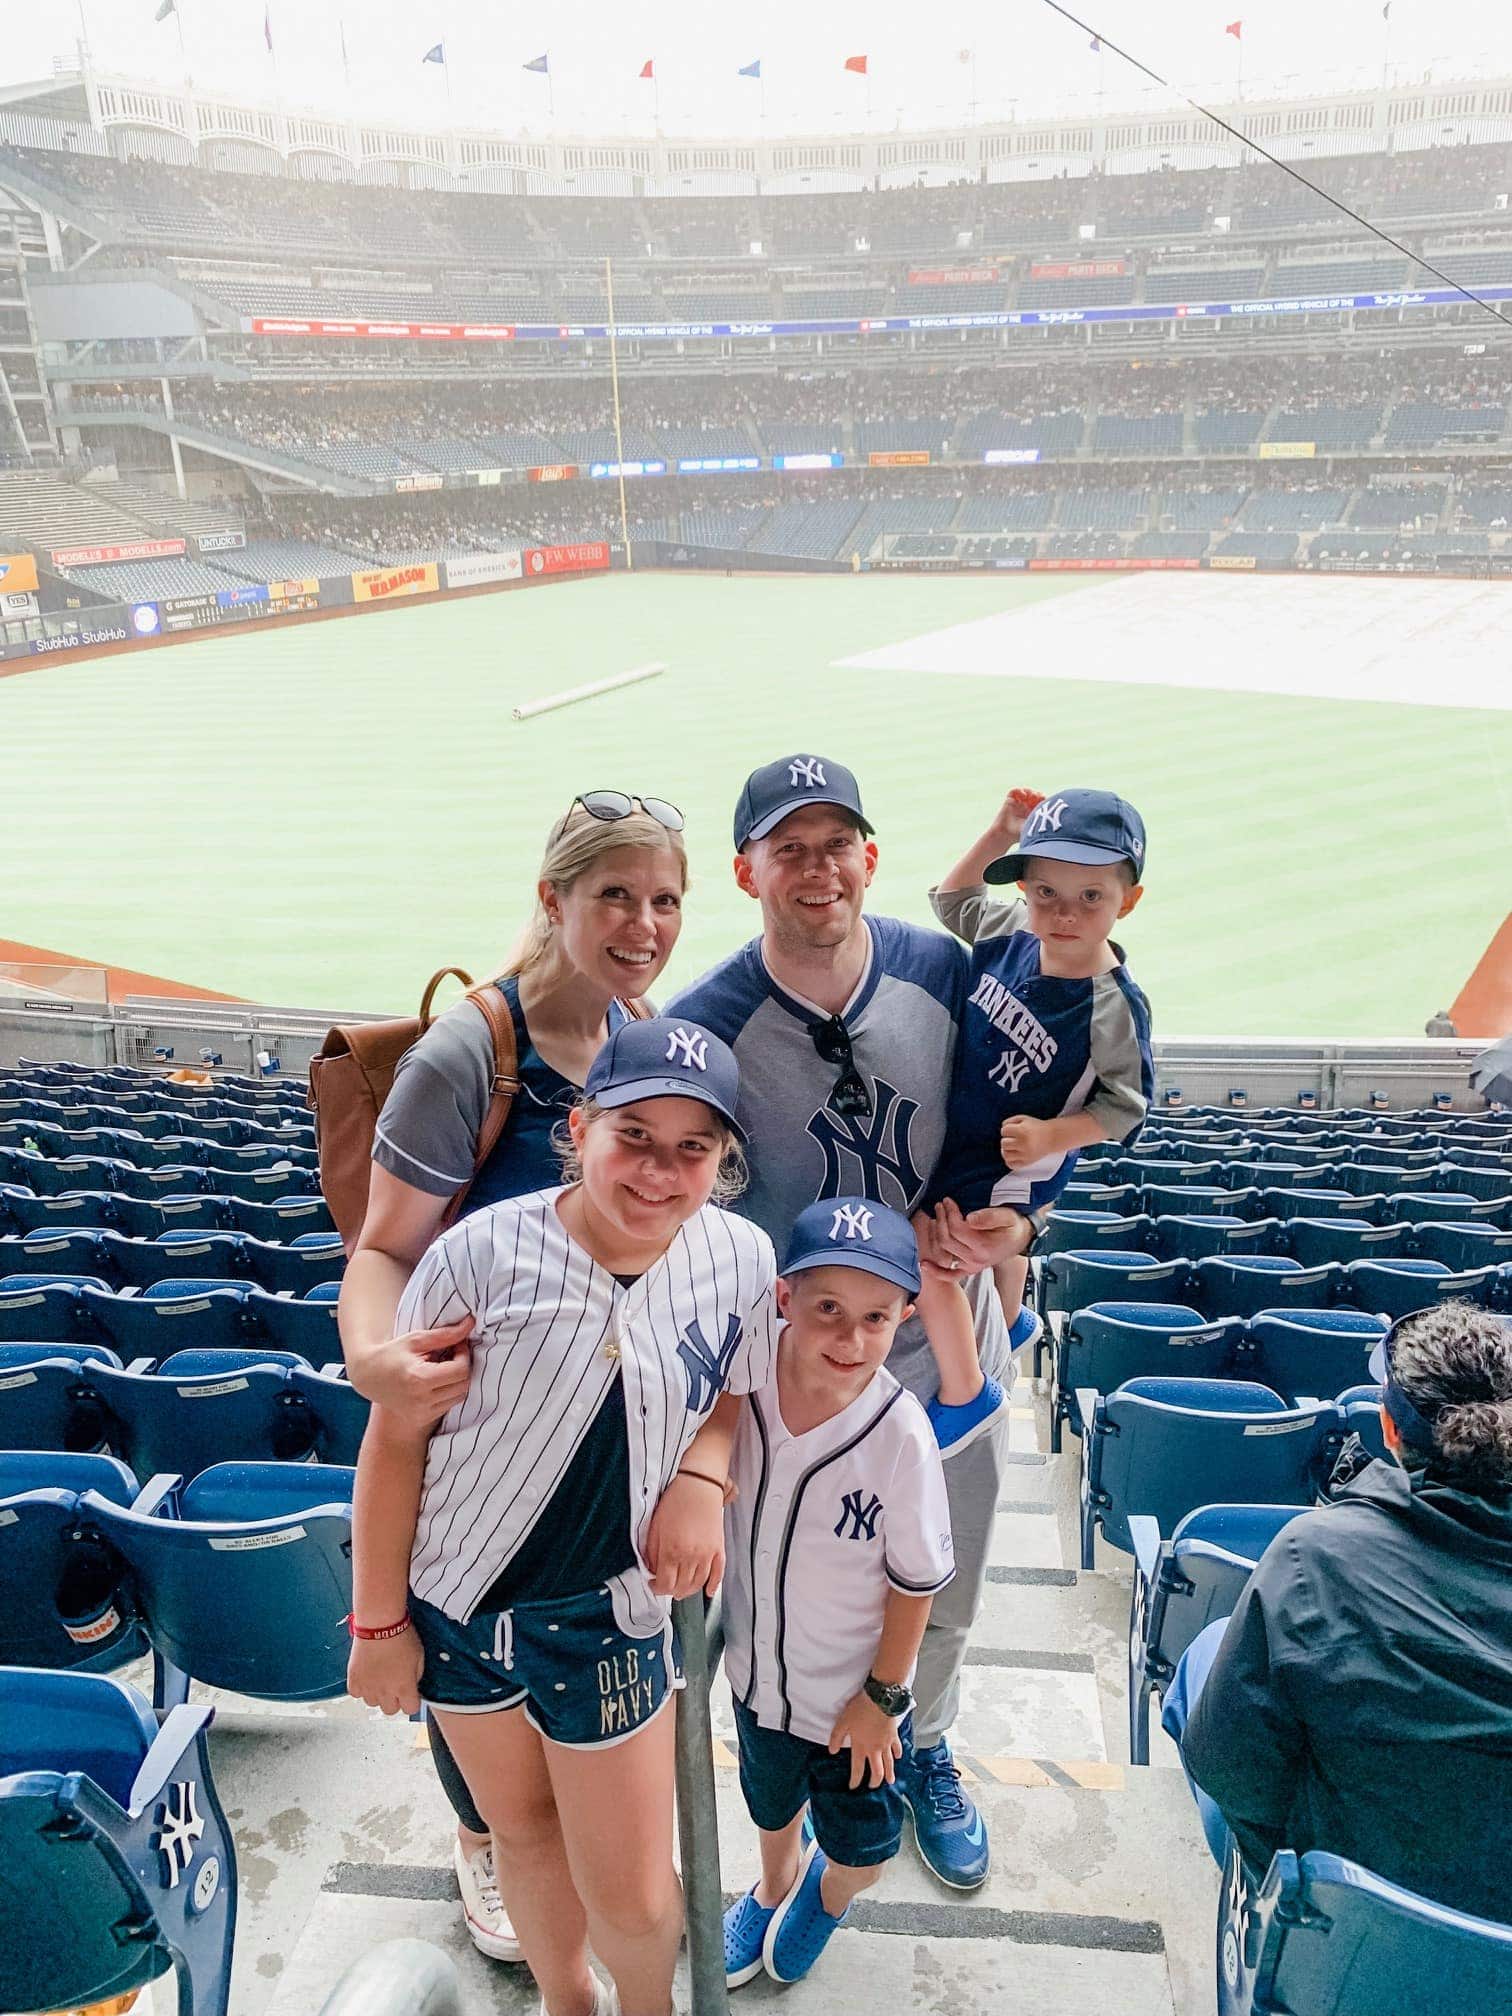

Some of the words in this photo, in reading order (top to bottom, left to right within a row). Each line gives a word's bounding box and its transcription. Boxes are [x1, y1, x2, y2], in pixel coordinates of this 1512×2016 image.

[10, 596, 26, 605] YES
[36, 633, 79, 652] StubHub
[82, 627, 126, 645] StubHub
[788, 758, 827, 787] NY
[1027, 798, 1069, 837] NY
[968, 972, 1059, 1074] YANKEES
[665, 1027, 708, 1072] NY
[988, 1050, 1031, 1093] NY
[805, 1074, 926, 1210] NY
[828, 1203, 875, 1241] NY
[833, 1488, 884, 1541] NY
[597, 1648, 639, 1696] OLD
[600, 1676, 655, 1735] NAVY
[201, 1870, 214, 1896] 12
